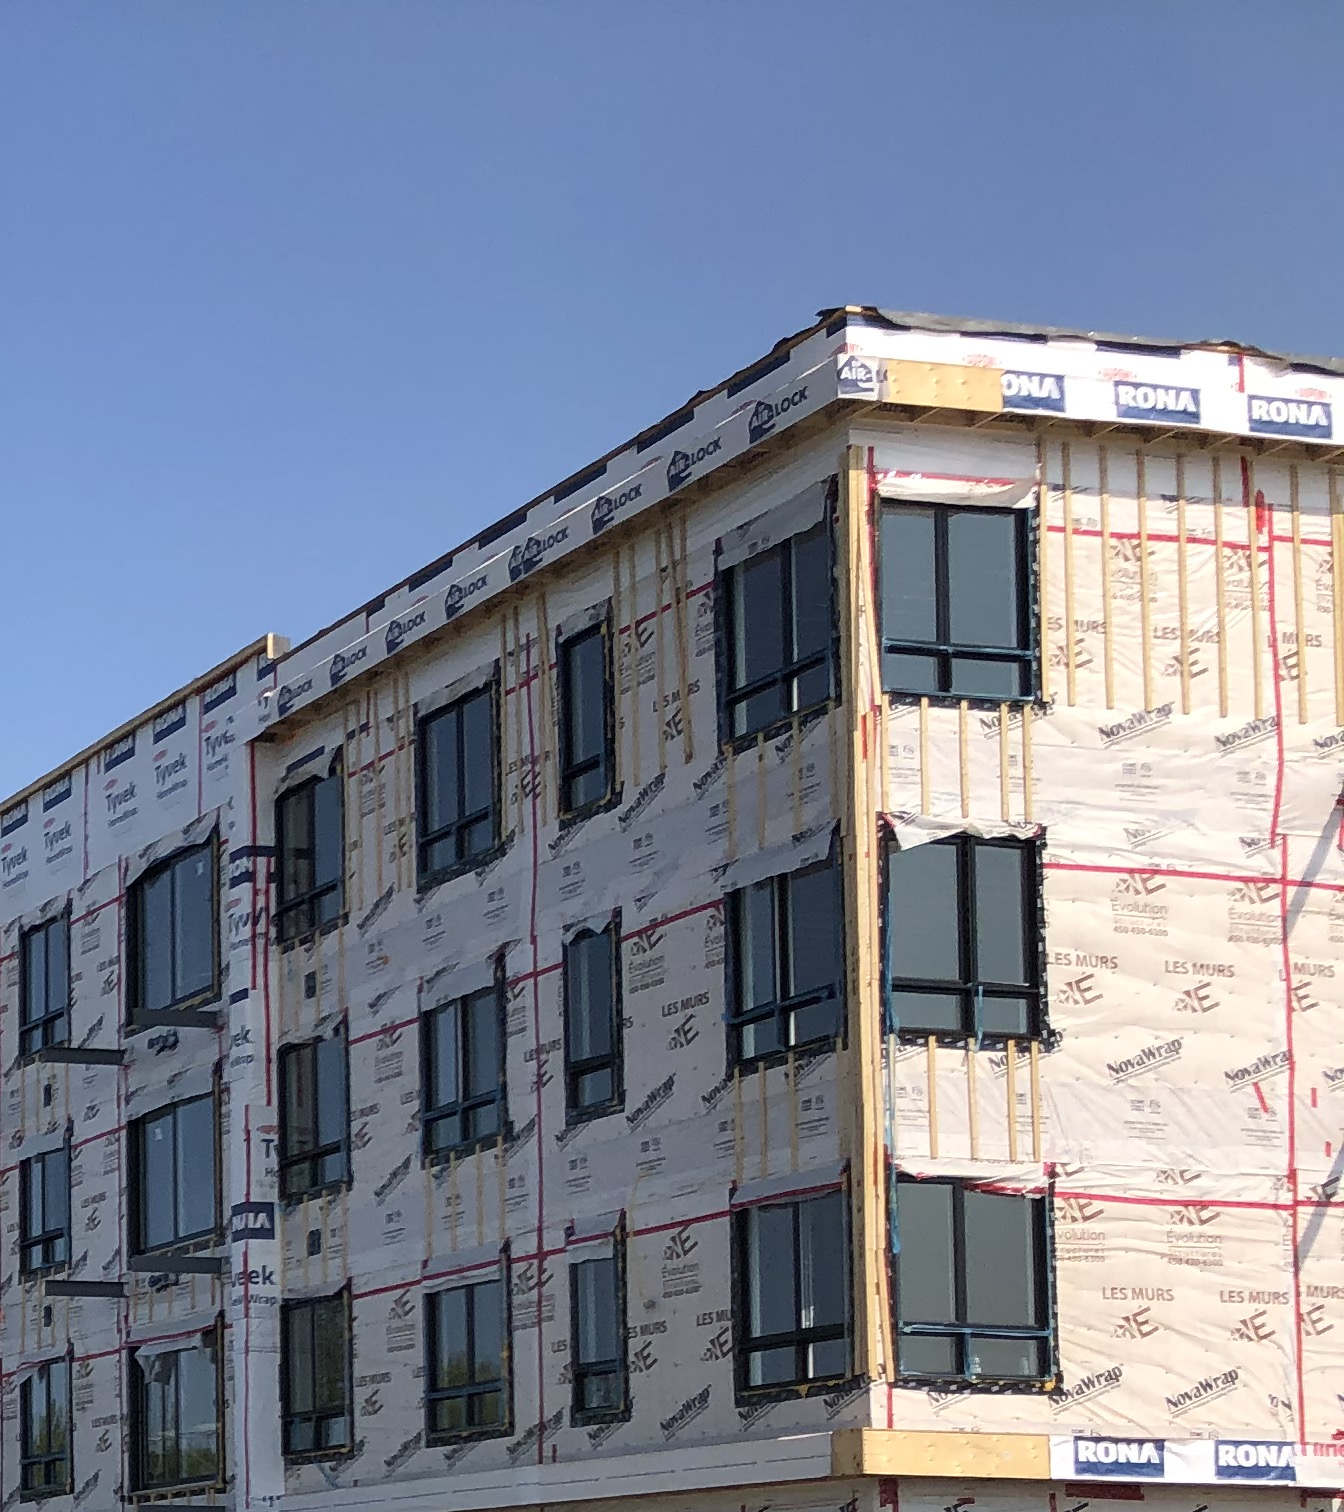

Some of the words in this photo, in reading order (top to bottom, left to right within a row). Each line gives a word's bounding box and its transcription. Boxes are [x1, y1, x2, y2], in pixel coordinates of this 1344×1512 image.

[1002, 373, 1061, 399] ONA
[1118, 385, 1197, 412] RONA
[1252, 400, 1329, 426] RONA
[1215, 714, 1278, 748] NovaWra
[1227, 905, 1281, 923] Évolutio
[1047, 953, 1072, 967] LES
[1076, 953, 1119, 970] MURS
[1164, 960, 1190, 975] LES
[1192, 962, 1235, 978] MURS
[1293, 961, 1335, 978] MURS
[1106, 1037, 1184, 1077] NovaWrap
[1224, 1049, 1291, 1084] NovaWra
[1057, 1228, 1106, 1242] volution
[1102, 1287, 1128, 1301] LES
[1131, 1287, 1175, 1302] MURS
[1219, 1290, 1246, 1304] LES
[1248, 1290, 1290, 1305] MURS
[1164, 1366, 1241, 1409] NovaWrap
[660, 1384, 712, 1432] NovaWrap
[1078, 1440, 1160, 1464] RONA
[1218, 1443, 1296, 1468] RONA
